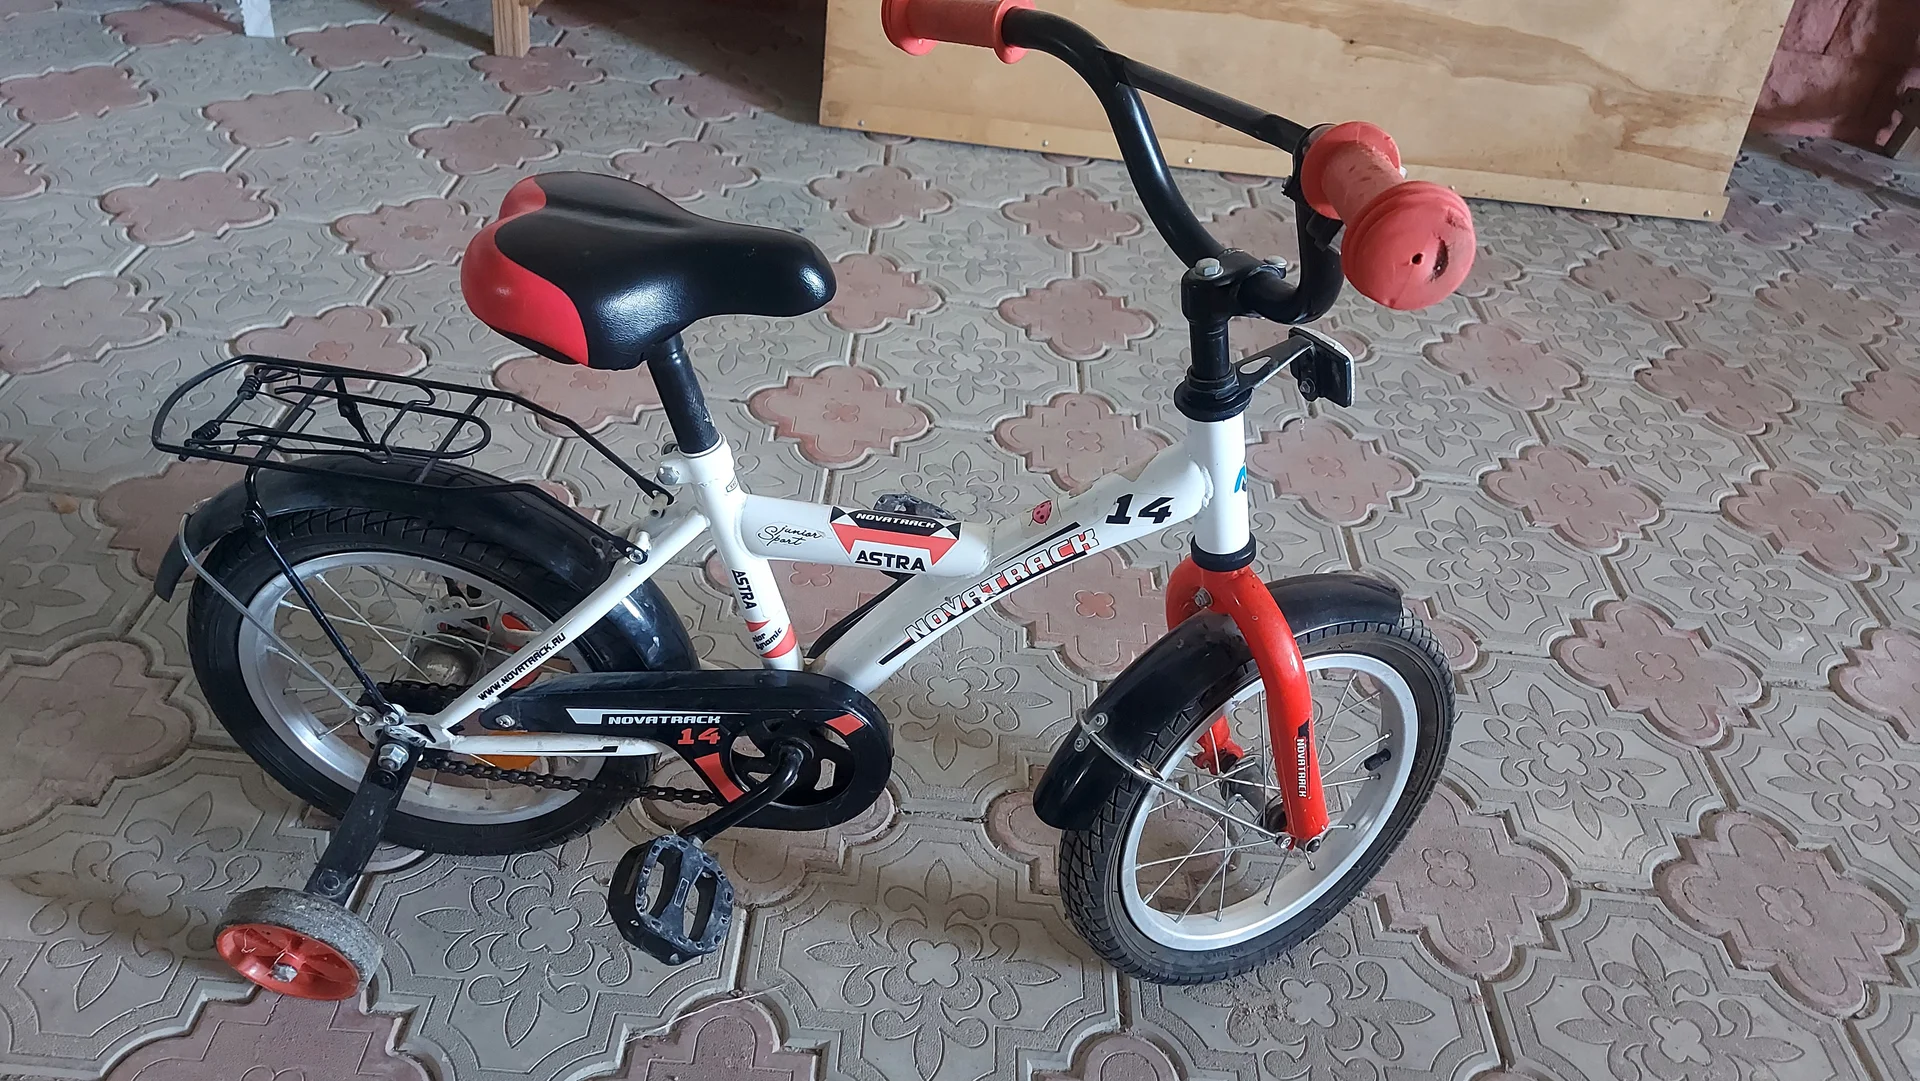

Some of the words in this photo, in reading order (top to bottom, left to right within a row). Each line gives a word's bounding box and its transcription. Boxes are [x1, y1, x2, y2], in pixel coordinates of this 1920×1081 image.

[856, 513, 937, 529] NOVATRACK
[1105, 494, 1175, 525] 14
[855, 550, 927, 572] ASTRA
[731, 569, 757, 610] ASTRA
[904, 528, 1100, 643] NOVATRACK
[477, 632, 566, 701] WWW.NOVATRACK.RU
[608, 715, 721, 725] NOVATRACK
[677, 727, 721, 745] 14
[1296, 738, 1307, 798] NOVATRACK
